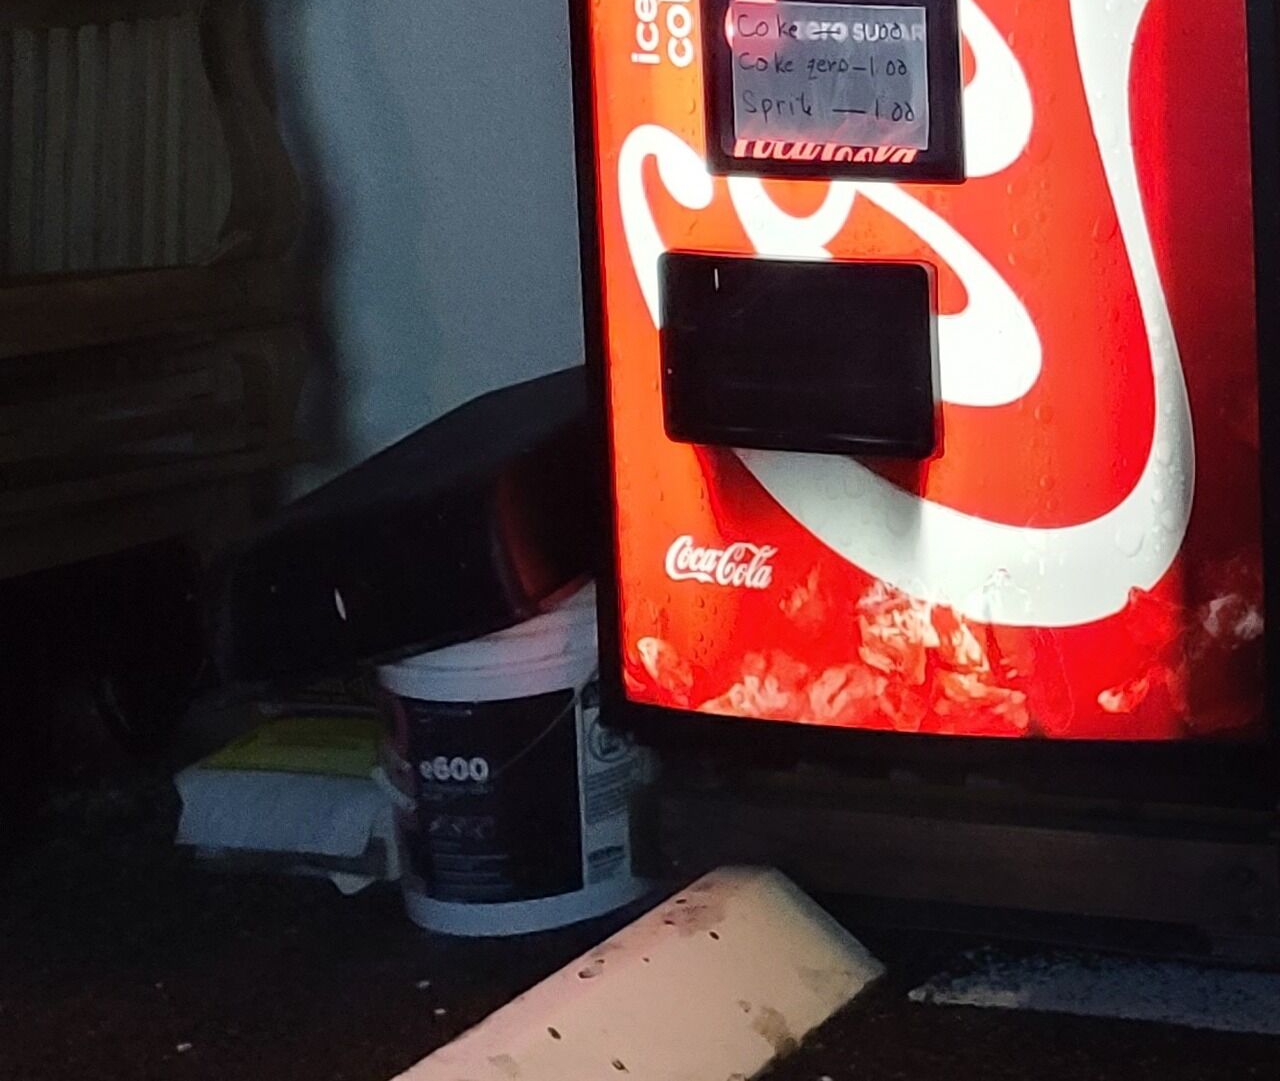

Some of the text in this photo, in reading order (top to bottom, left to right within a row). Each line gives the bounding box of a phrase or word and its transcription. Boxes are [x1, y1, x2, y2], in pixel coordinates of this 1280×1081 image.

[736, 13, 798, 39] Coke
[738, 52, 795, 73] Coke
[665, 535, 778, 589] Coca-Cola
